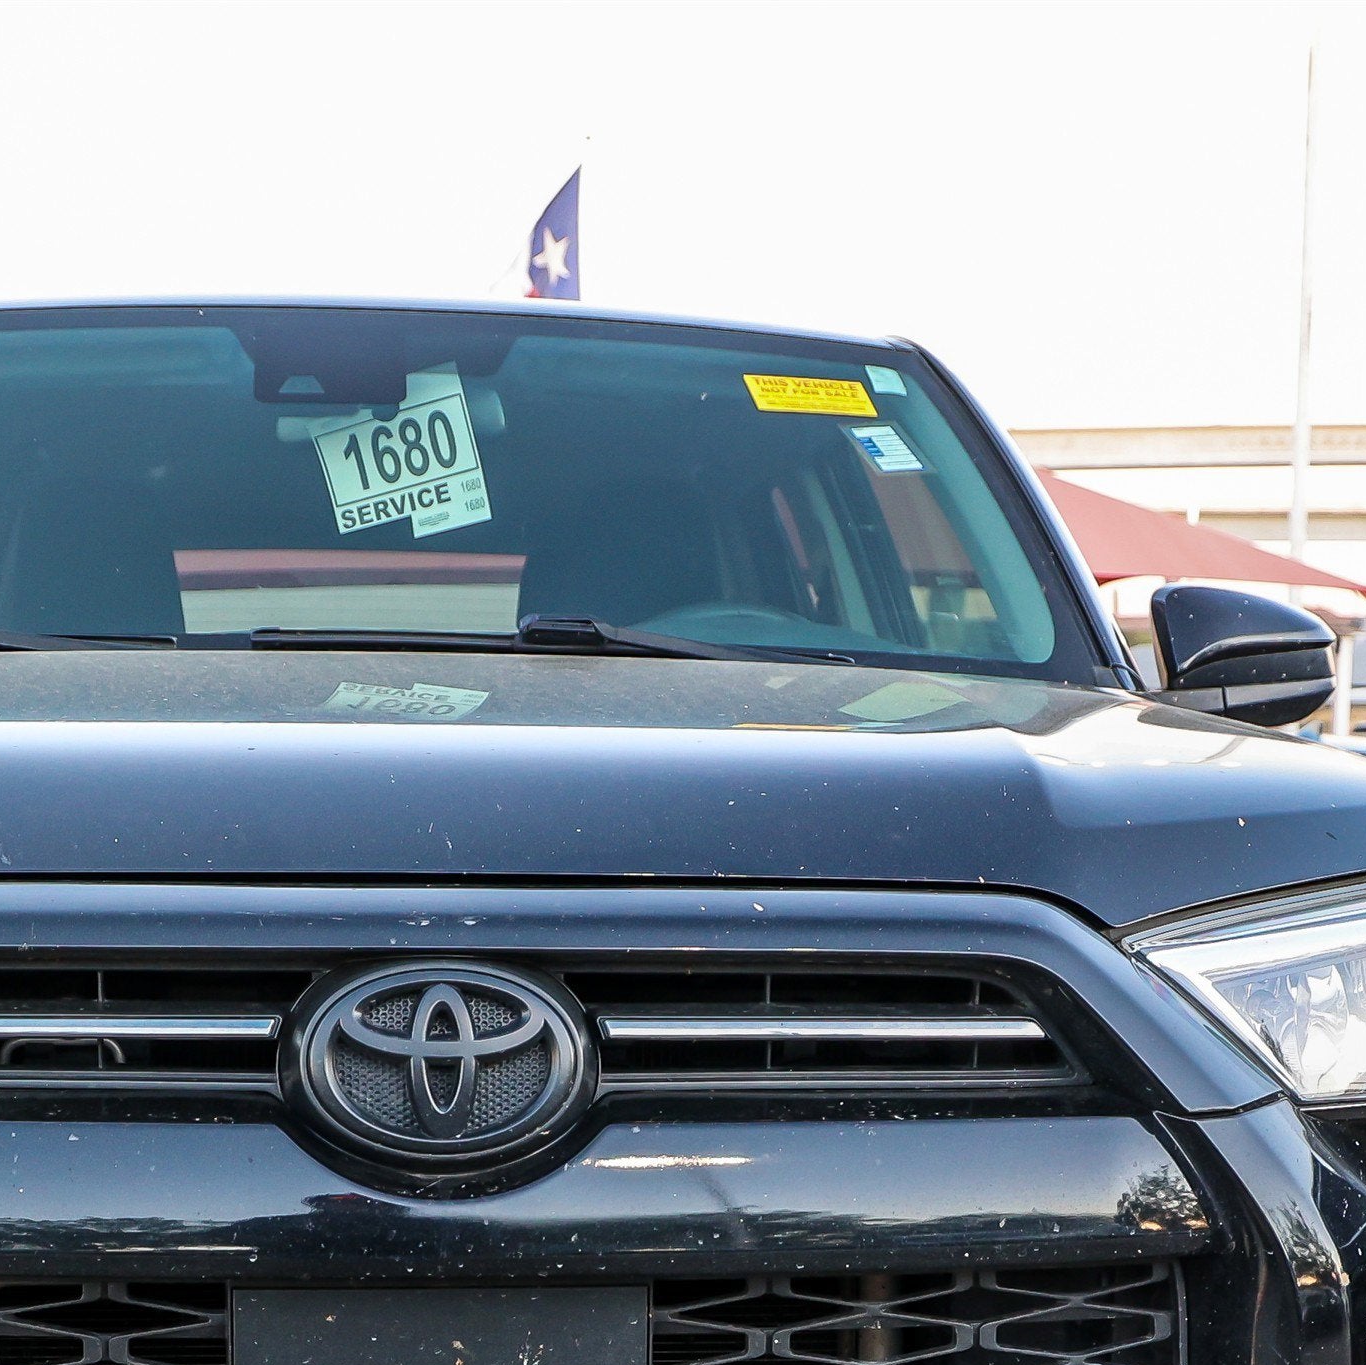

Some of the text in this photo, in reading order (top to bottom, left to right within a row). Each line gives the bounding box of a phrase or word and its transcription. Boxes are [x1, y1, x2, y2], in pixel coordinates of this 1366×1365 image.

[755, 377, 860, 392] THIS VEHICLE
[760, 386, 787, 394] NOT
[825, 389, 860, 398] SALE
[343, 409, 457, 491] 1680
[460, 477, 482, 493] 1680
[340, 482, 452, 530] SERVICE
[464, 496, 486, 513] 1680
